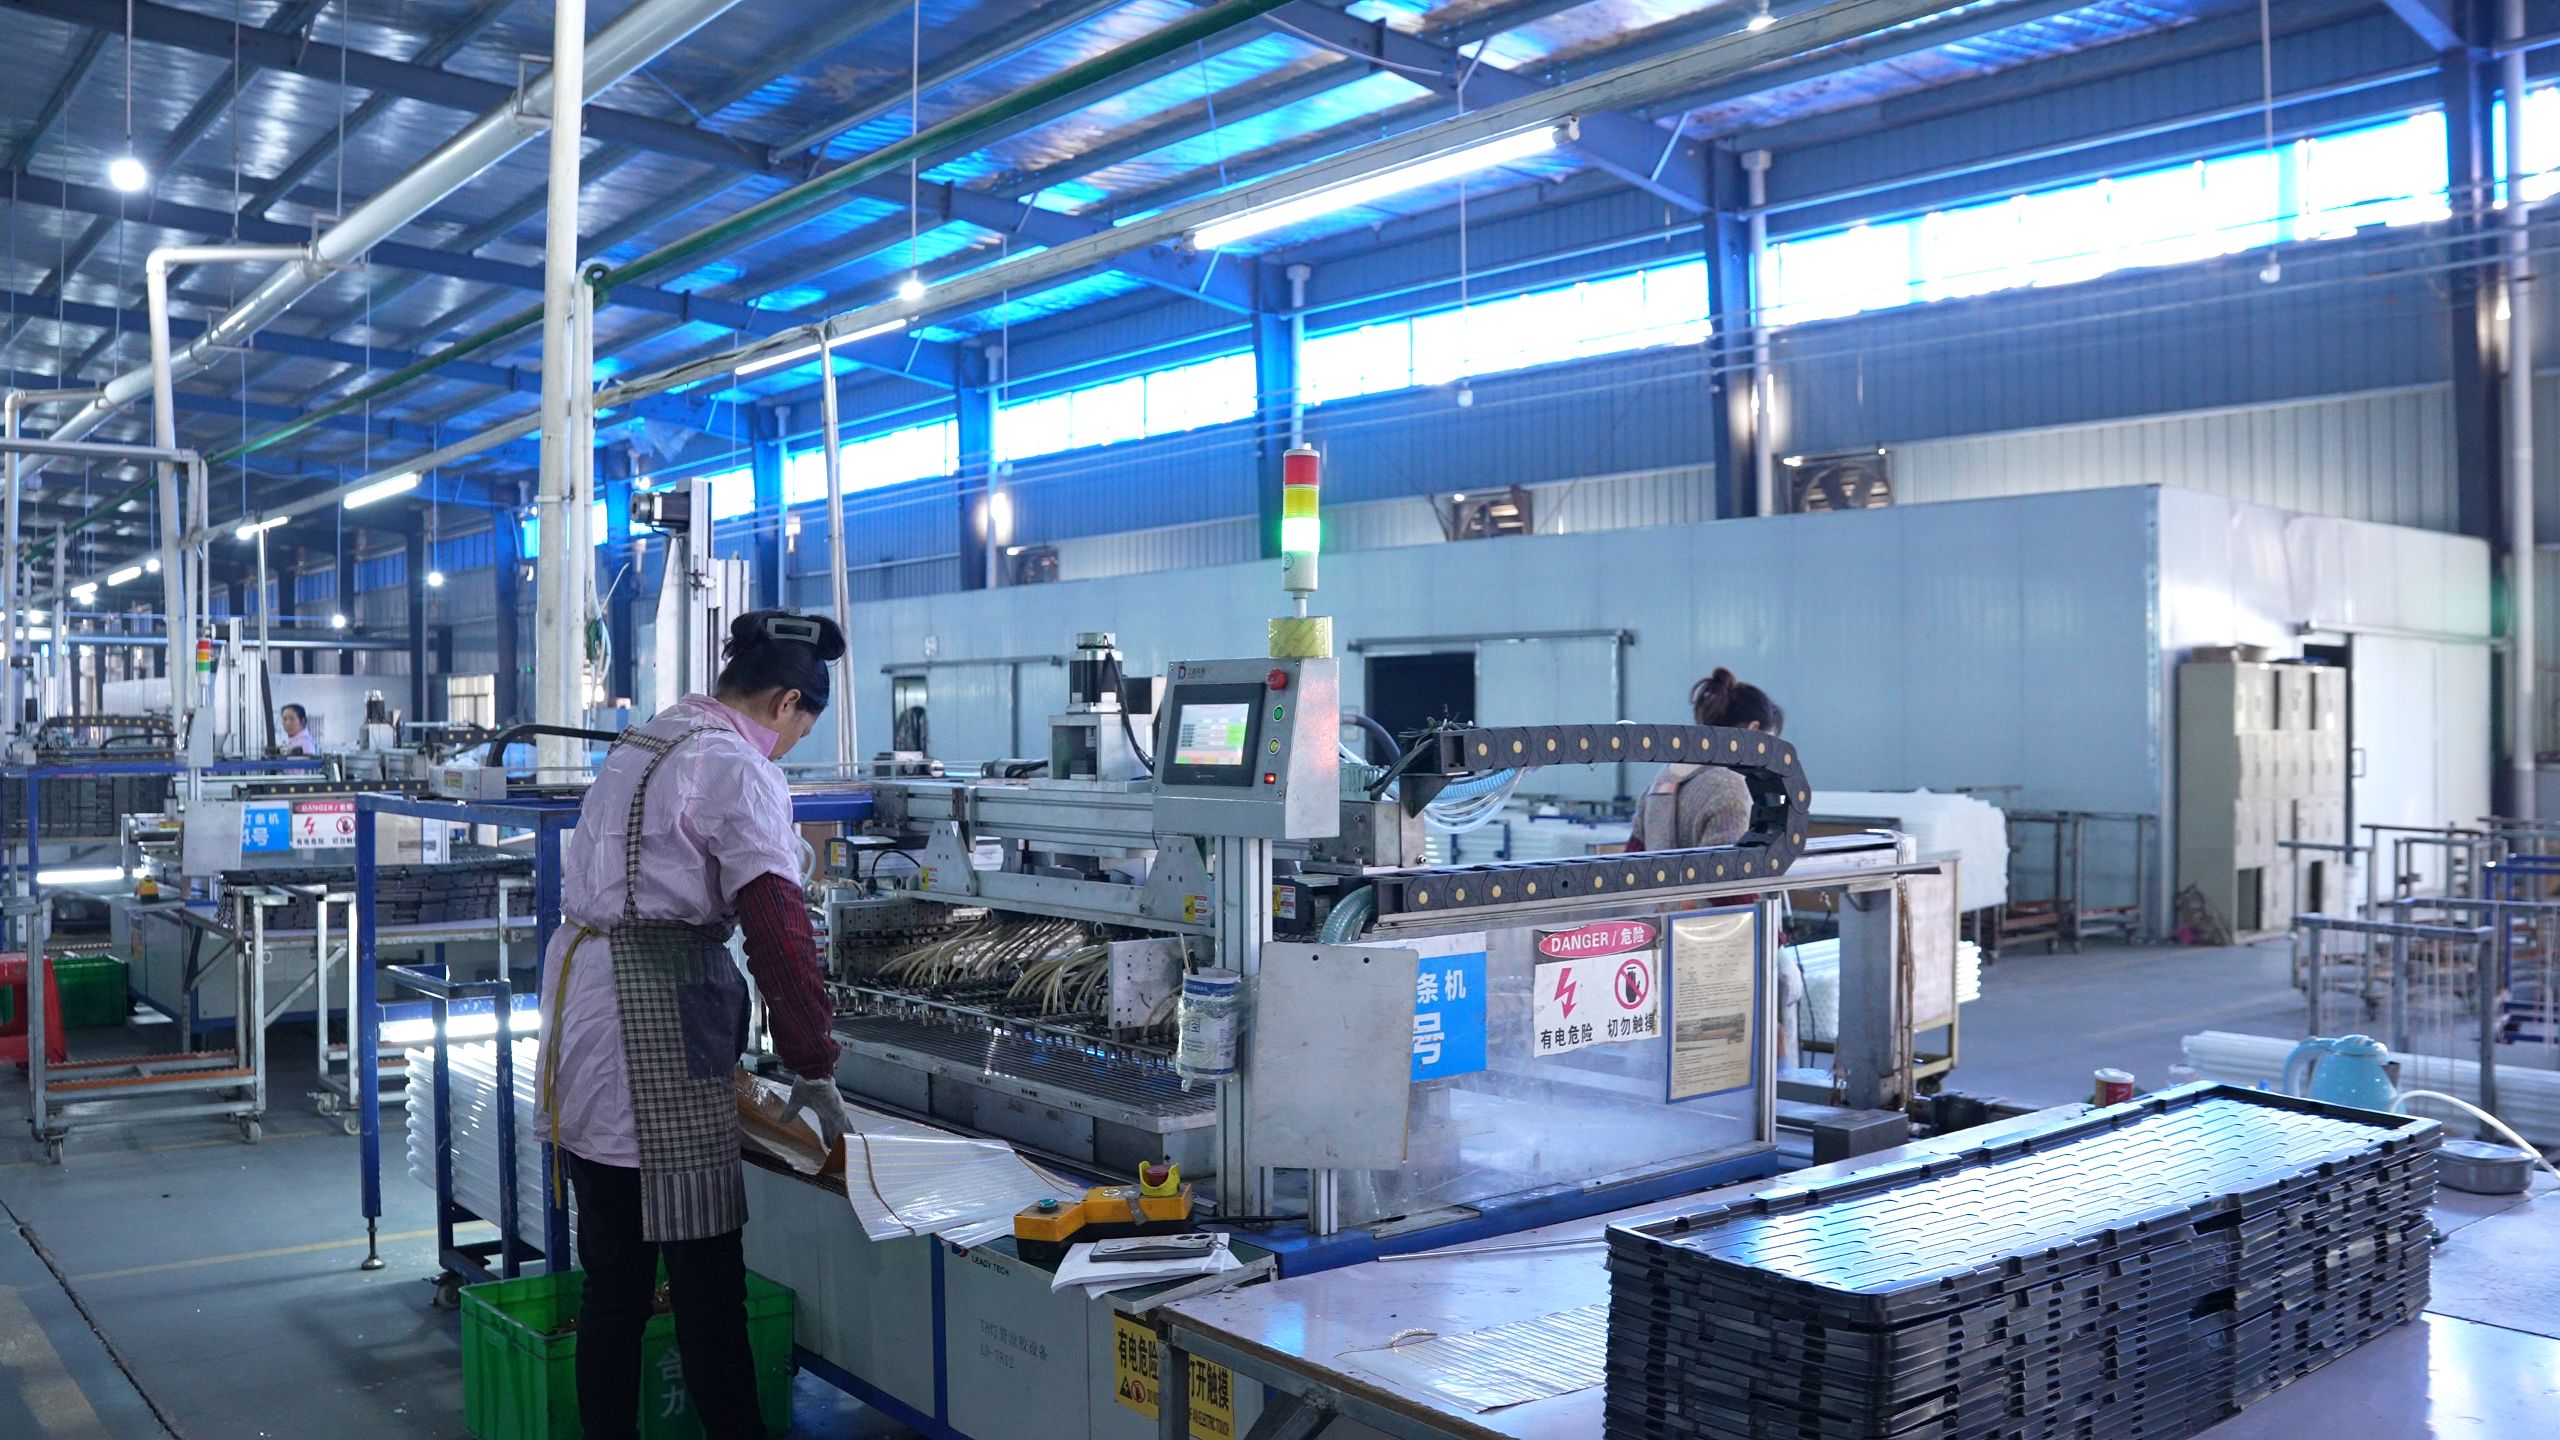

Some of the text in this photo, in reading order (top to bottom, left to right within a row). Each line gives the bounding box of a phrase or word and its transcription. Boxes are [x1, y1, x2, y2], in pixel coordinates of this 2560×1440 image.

[301, 803, 333, 812] DANGER
[333, 837, 356, 845] 切勿触
[1551, 931, 1609, 952] DANGER
[1620, 926, 1645, 945] 危险
[1416, 969, 1467, 1004] 条机
[1540, 1023, 1593, 1049] 有电危险
[1607, 1012, 1656, 1038] 切勿触摸
[1412, 1012, 1445, 1065] 号
[992, 1263, 1010, 1277] TECH
[1118, 1327, 1159, 1380] 有电危险
